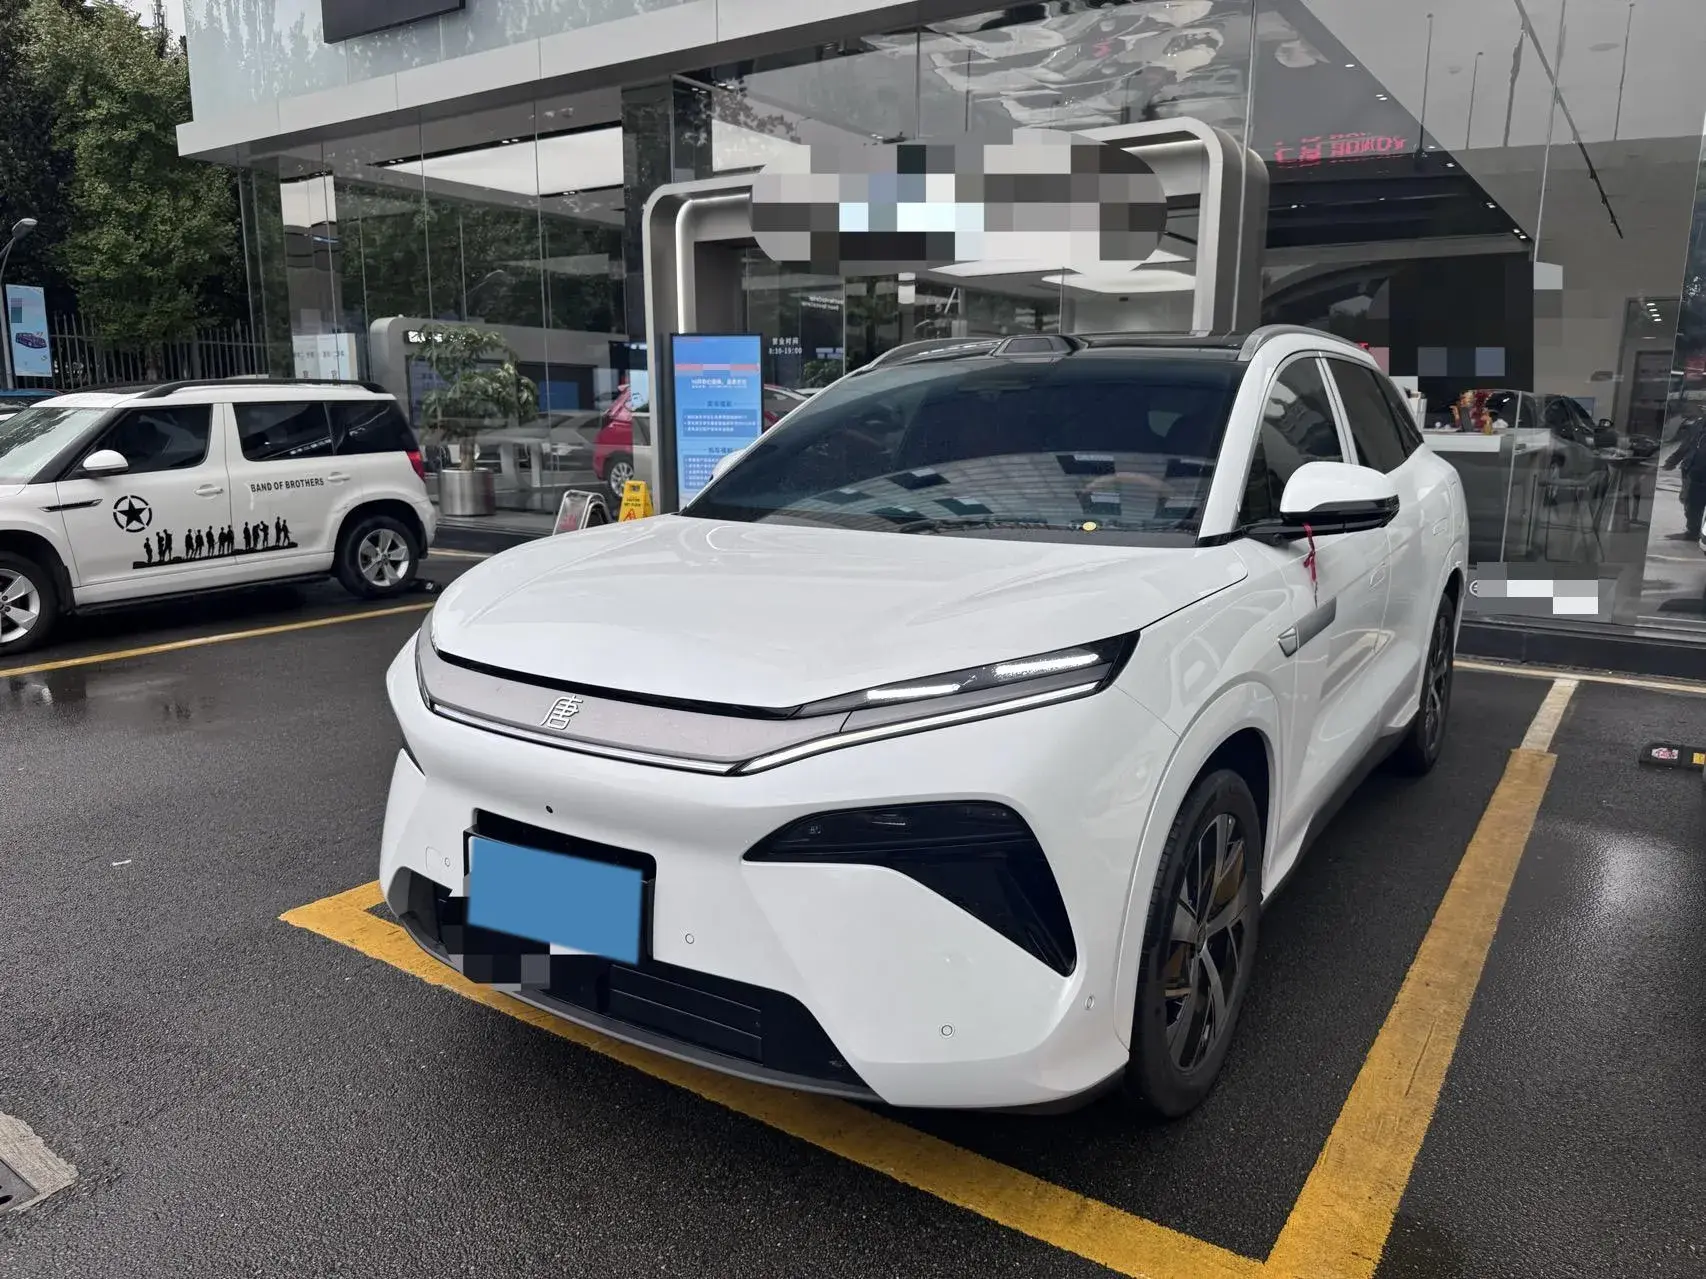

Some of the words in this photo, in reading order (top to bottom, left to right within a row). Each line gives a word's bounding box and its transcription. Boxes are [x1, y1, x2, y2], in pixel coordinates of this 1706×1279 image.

[250, 482, 273, 493] BAND
[273, 481, 284, 491] OF
[285, 478, 325, 489] BROTHERS
[540, 694, 584, 731] 唐
